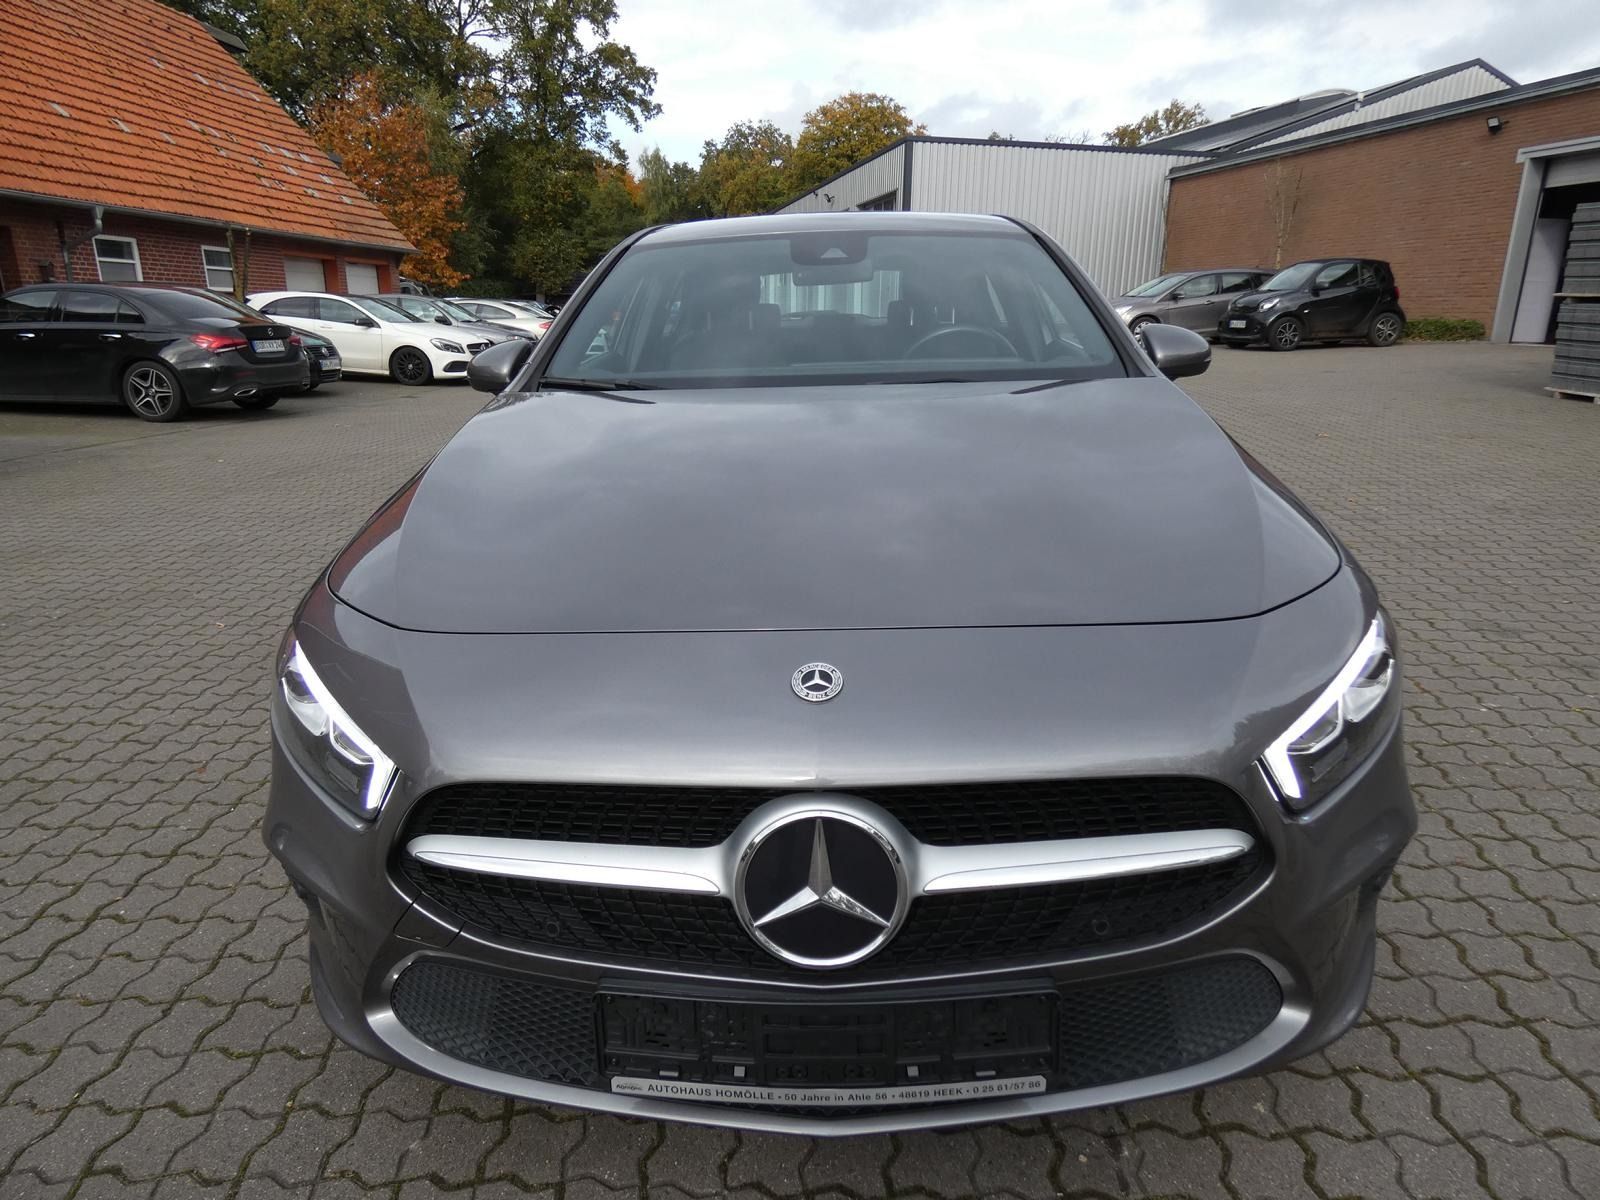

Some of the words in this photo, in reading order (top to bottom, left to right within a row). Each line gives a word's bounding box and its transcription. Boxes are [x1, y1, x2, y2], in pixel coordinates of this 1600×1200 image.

[648, 1083, 712, 1096] AUTOHAUS
[716, 1089, 775, 1100] HOMÖLLE
[784, 1093, 797, 1101] 50
[800, 1093, 830, 1101] Jahre
[834, 1093, 844, 1101] in
[848, 1093, 870, 1101] Ahle
[933, 1087, 963, 1097] HEEK
